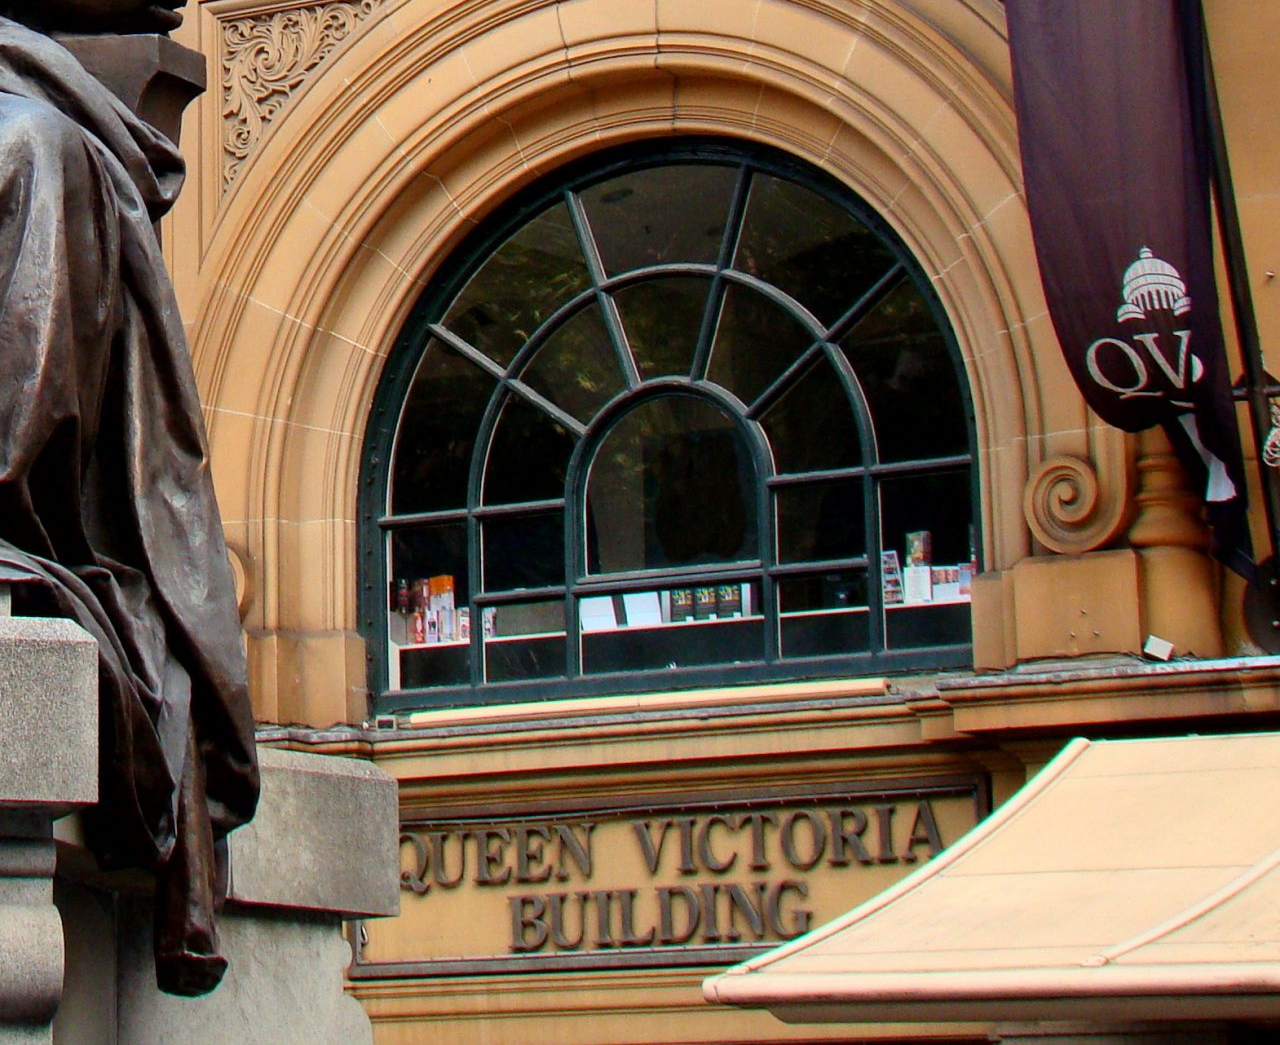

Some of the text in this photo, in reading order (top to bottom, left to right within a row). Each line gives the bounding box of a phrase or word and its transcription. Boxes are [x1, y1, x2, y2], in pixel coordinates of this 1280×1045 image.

[1086, 329, 1204, 400] QV
[399, 799, 945, 894] QUEEN VICTORIA
[507, 879, 813, 952] BUILDING
